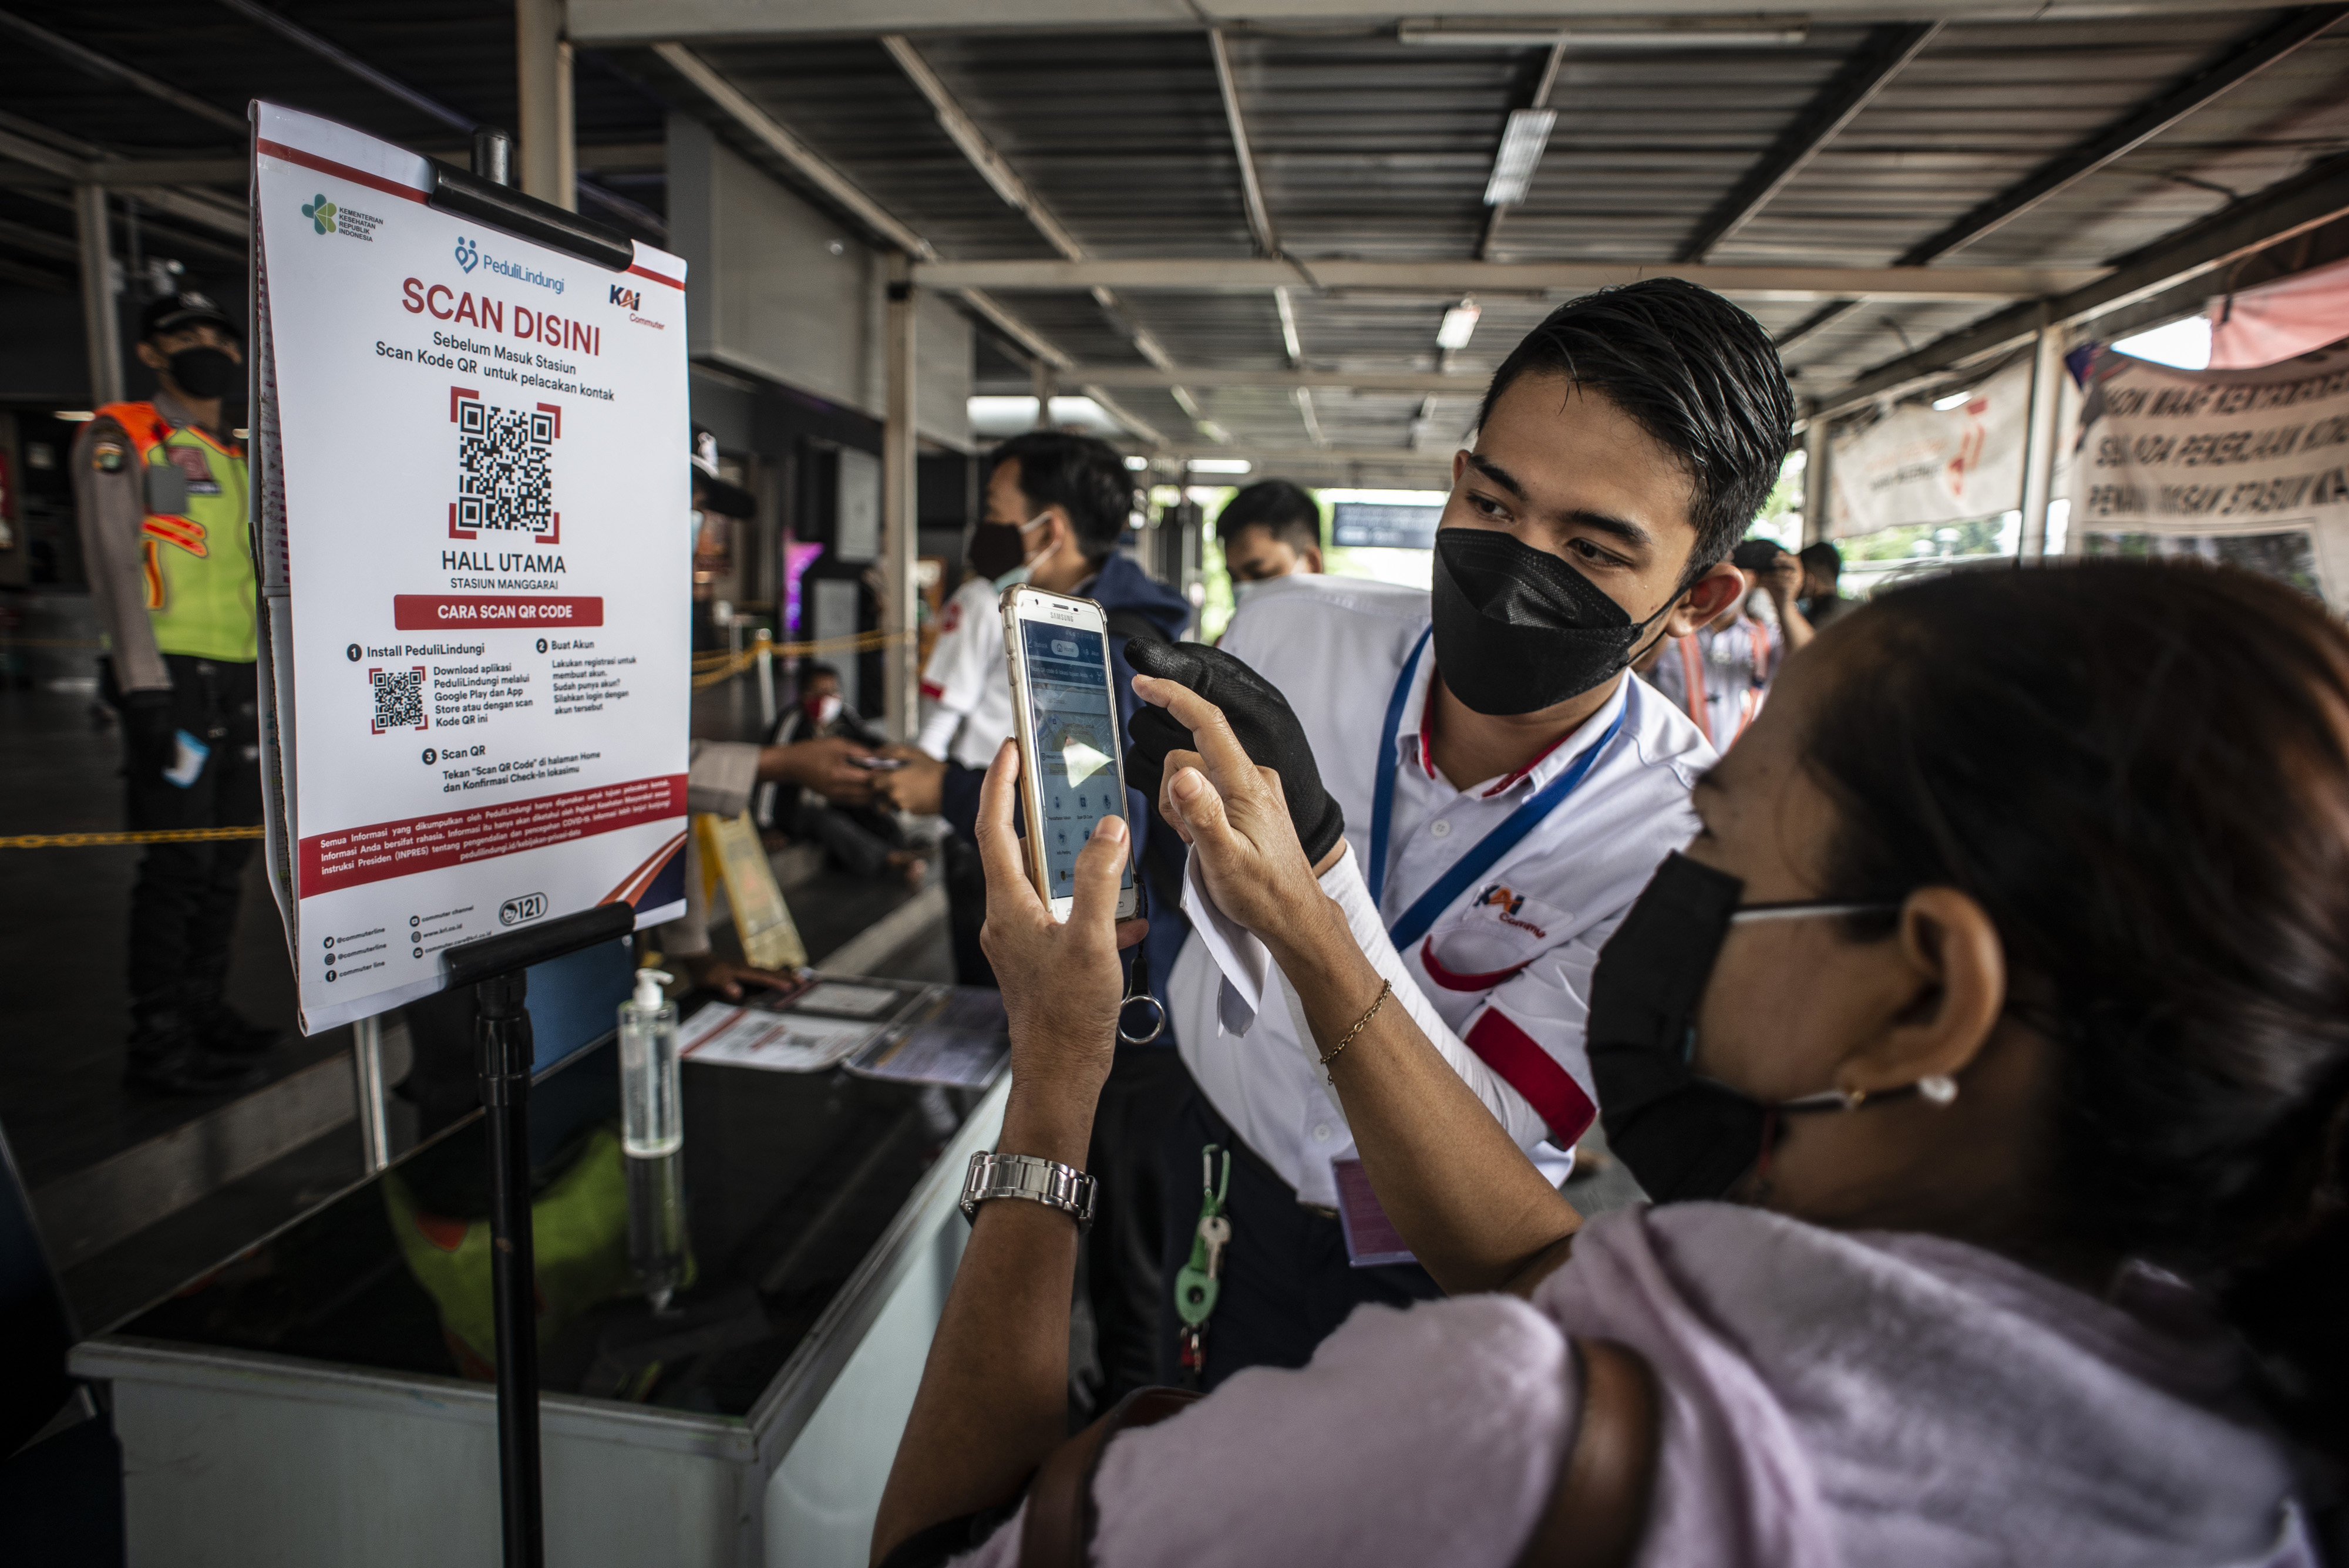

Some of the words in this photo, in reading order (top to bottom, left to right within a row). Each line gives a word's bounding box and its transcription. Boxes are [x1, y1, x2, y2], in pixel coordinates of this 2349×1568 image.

[339, 207, 383, 225] KEMENTERIAN
[339, 214, 376, 229] KESEHATAN
[339, 221, 370, 234] REPUBLIK
[339, 228, 373, 242] INDONESIA
[483, 254, 564, 294] PeduliLindungi
[609, 284, 641, 311] KAI
[402, 277, 503, 333] SCAN
[514, 305, 600, 356] DISINI
[630, 312, 665, 330] Commuter
[433, 331, 490, 356] Sebelum
[494, 345, 533, 365] Masuk
[536, 355, 576, 375] Stasiun
[376, 341, 413, 361] Scan
[418, 349, 454, 369] Kode
[457, 358, 477, 374] QR
[484, 365, 518, 382] untuk
[521, 373, 577, 394] pelacakan
[580, 383, 615, 402] kontak
[442, 550, 494, 571] HALL
[499, 553, 567, 573] UTAMA
[450, 578, 495, 589] STASIUN
[497, 579, 558, 590] MANGGARAI
[438, 605, 477, 619] CARA
[480, 605, 516, 618] SCAN
[519, 605, 537, 619] QR
[539, 605, 573, 618] CODE
[1050, 612, 1074, 622] SAMSUNG
[351, 648, 358, 658] 1
[367, 645, 402, 658] Install
[405, 643, 485, 656] PeduliLindungi
[539, 641, 546, 651] 2
[551, 640, 571, 650] Buat
[573, 640, 595, 649] Akun
[433, 664, 479, 675] Download
[481, 662, 512, 674] aplikasi
[552, 658, 583, 668] Lakukan
[584, 657, 616, 668] registrasi
[617, 655, 637, 664] untuk
[434, 675, 499, 688] PeduliLindungi
[501, 674, 530, 684] melalui
[553, 670, 587, 679] membuat
[553, 682, 576, 691] Sudah
[578, 681, 599, 691] punya
[601, 678, 621, 688] akun?
[435, 691, 467, 702] Google
[470, 689, 488, 699] Play
[490, 688, 504, 697] dan
[507, 687, 523, 698] App
[554, 694, 584, 703] Silahkan
[586, 692, 603, 701] login
[605, 690, 630, 699] dengan
[435, 705, 460, 714] Store
[462, 704, 482, 712] atau
[483, 701, 513, 711] dengan
[515, 699, 533, 708] scan
[554, 706, 573, 715] akun
[574, 704, 604, 712] tersebut
[436, 716, 460, 727] Kode
[462, 715, 475, 725] QR
[477, 714, 488, 723] ini
[426, 752, 433, 761] 3
[442, 748, 467, 759] Scan
[470, 745, 486, 756] QR
[443, 770, 470, 780] Tekan
[499, 763, 511, 772] QR
[539, 758, 546, 766] di
[548, 754, 579, 765] halaman
[580, 751, 601, 761] Home
[443, 782, 460, 792] dan
[463, 776, 509, 790] Konfirmasi
[547, 766, 580, 777] lokasimu
[320, 836, 347, 849] Semua
[351, 828, 388, 842] Informasi
[392, 826, 411, 836] yang
[415, 816, 463, 831] dikumpulkan
[467, 813, 482, 822] oleh
[485, 804, 532, 818] PeduliLindungi
[534, 800, 553, 810] hanya
[321, 849, 358, 862] Informasi
[359, 843, 381, 854] Anda
[384, 837, 413, 849] bersifat
[416, 830, 445, 843] rahasia.
[447, 825, 481, 838] Informasi
[483, 823, 492, 832] itu
[494, 820, 513, 830] hanya
[515, 816, 531, 826] akan
[321, 862, 355, 875] instruksi
[358, 853, 392, 867] Presiden
[395, 846, 429, 862] (INPRES)
[432, 841, 460, 853] tentang
[463, 833, 508, 849] pengendalian
[510, 829, 522, 839] dan
[518, 896, 541, 919] 121
[1472, 884, 1526, 916] KAI
[336, 927, 385, 944] @commuterline
[338, 943, 387, 960] @commuterline
[339, 964, 372, 977] commuter
